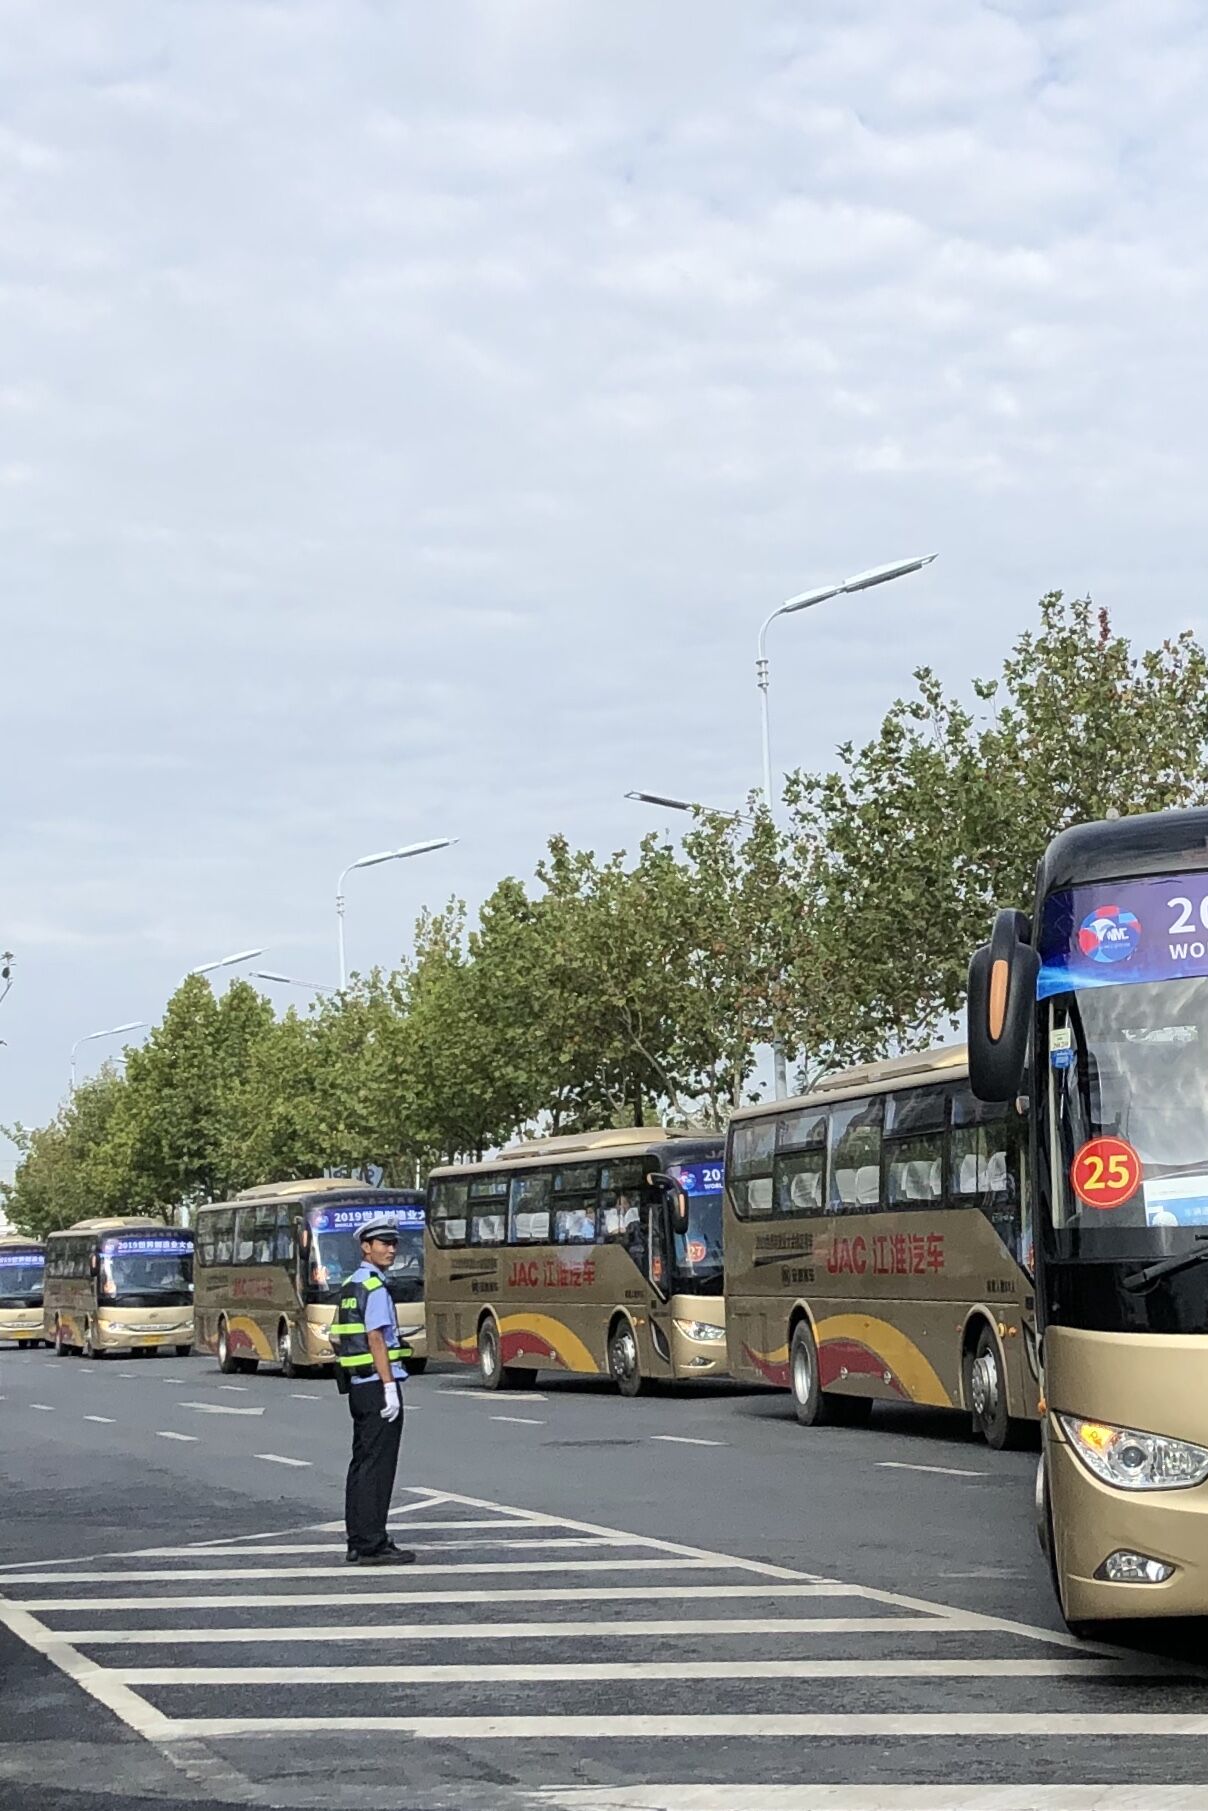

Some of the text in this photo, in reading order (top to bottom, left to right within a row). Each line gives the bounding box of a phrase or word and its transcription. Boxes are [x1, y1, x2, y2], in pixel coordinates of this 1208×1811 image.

[1083, 1154, 1130, 1190] 25
[827, 1236, 867, 1275] JAC
[873, 1232, 945, 1275] 江淮汽车
[508, 1261, 539, 1287] JAC
